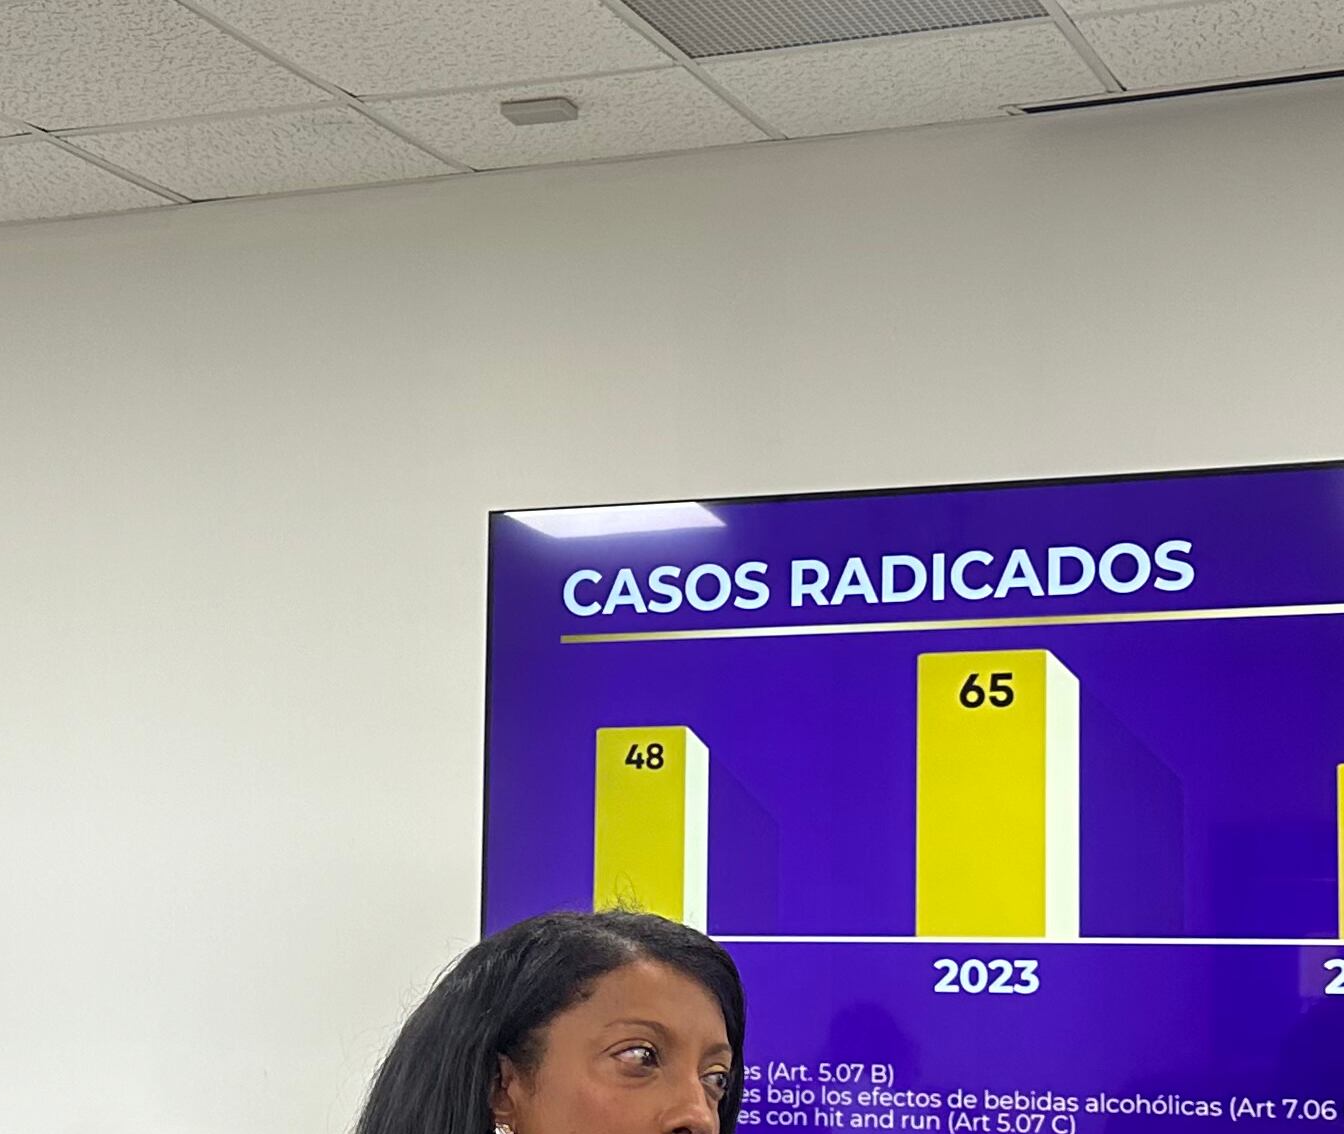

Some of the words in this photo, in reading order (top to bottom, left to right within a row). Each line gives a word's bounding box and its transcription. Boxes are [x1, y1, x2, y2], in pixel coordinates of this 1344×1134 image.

[562, 561, 771, 617] CASOS
[790, 540, 1196, 607] RADICADOS
[959, 672, 1015, 709] 65
[624, 742, 665, 770] 48
[933, 958, 1040, 995] 2023
[767, 1061, 814, 1085] (Art.
[818, 1063, 864, 1083] 5.07
[871, 1064, 895, 1087] B)
[766, 1110, 808, 1126] con
[814, 1107, 844, 1128] hit
[850, 1108, 894, 1130] and
[900, 1113, 941, 1131] run
[995, 1114, 1045, 1134] 5.07
[767, 1084, 816, 1109] bajo
[821, 1086, 853, 1106] los
[857, 1087, 942, 1110] efectos
[947, 1088, 978, 1110] de
[984, 1090, 1080, 1114] bebidas
[1084, 1092, 1223, 1118] alcohólicas
[1230, 1096, 1276, 1122] (Art
[1281, 1098, 1338, 1121] 7.06
